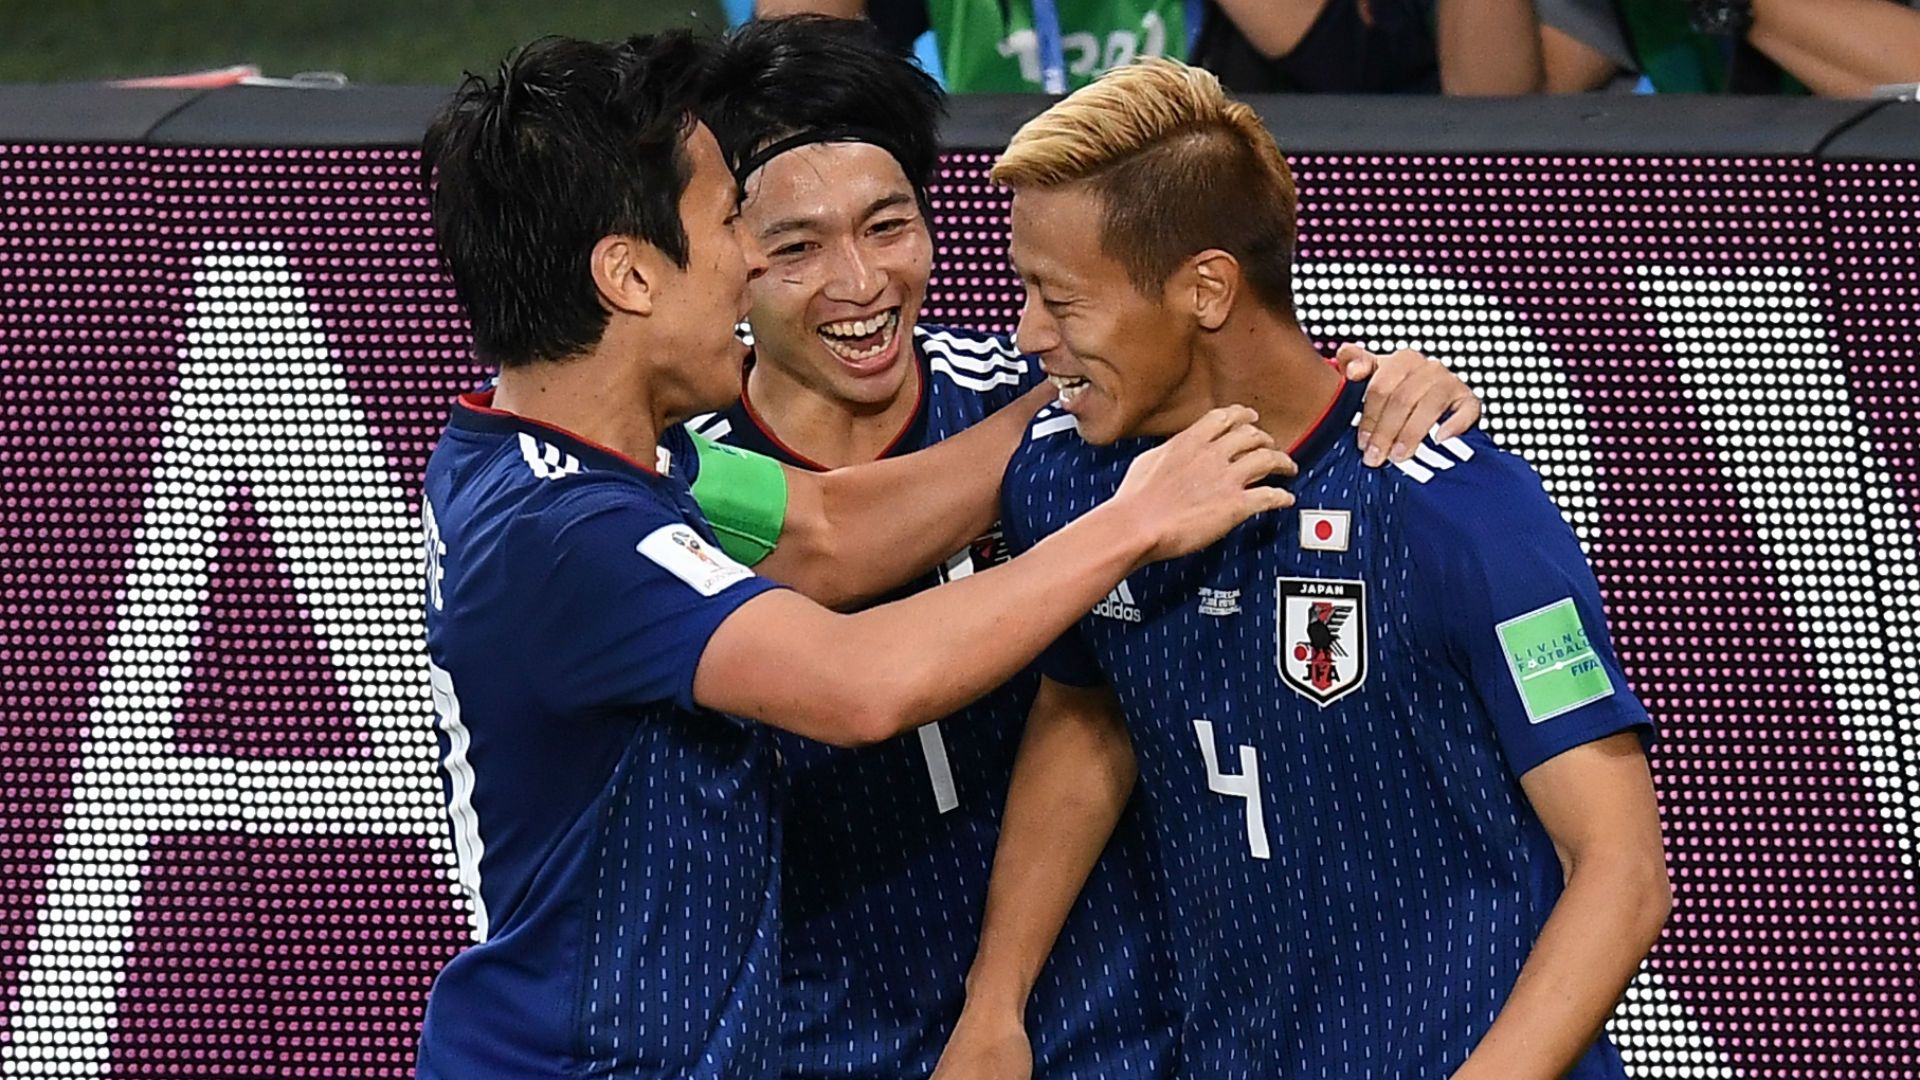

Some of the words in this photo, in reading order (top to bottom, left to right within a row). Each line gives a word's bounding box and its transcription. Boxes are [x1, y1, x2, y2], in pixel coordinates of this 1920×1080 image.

[1300, 584, 1344, 595] JAPAN
[1092, 600, 1142, 623] adidas
[1302, 664, 1341, 682] JFA
[1571, 659, 1599, 677] FIFA
[1193, 719, 1270, 859] 4
